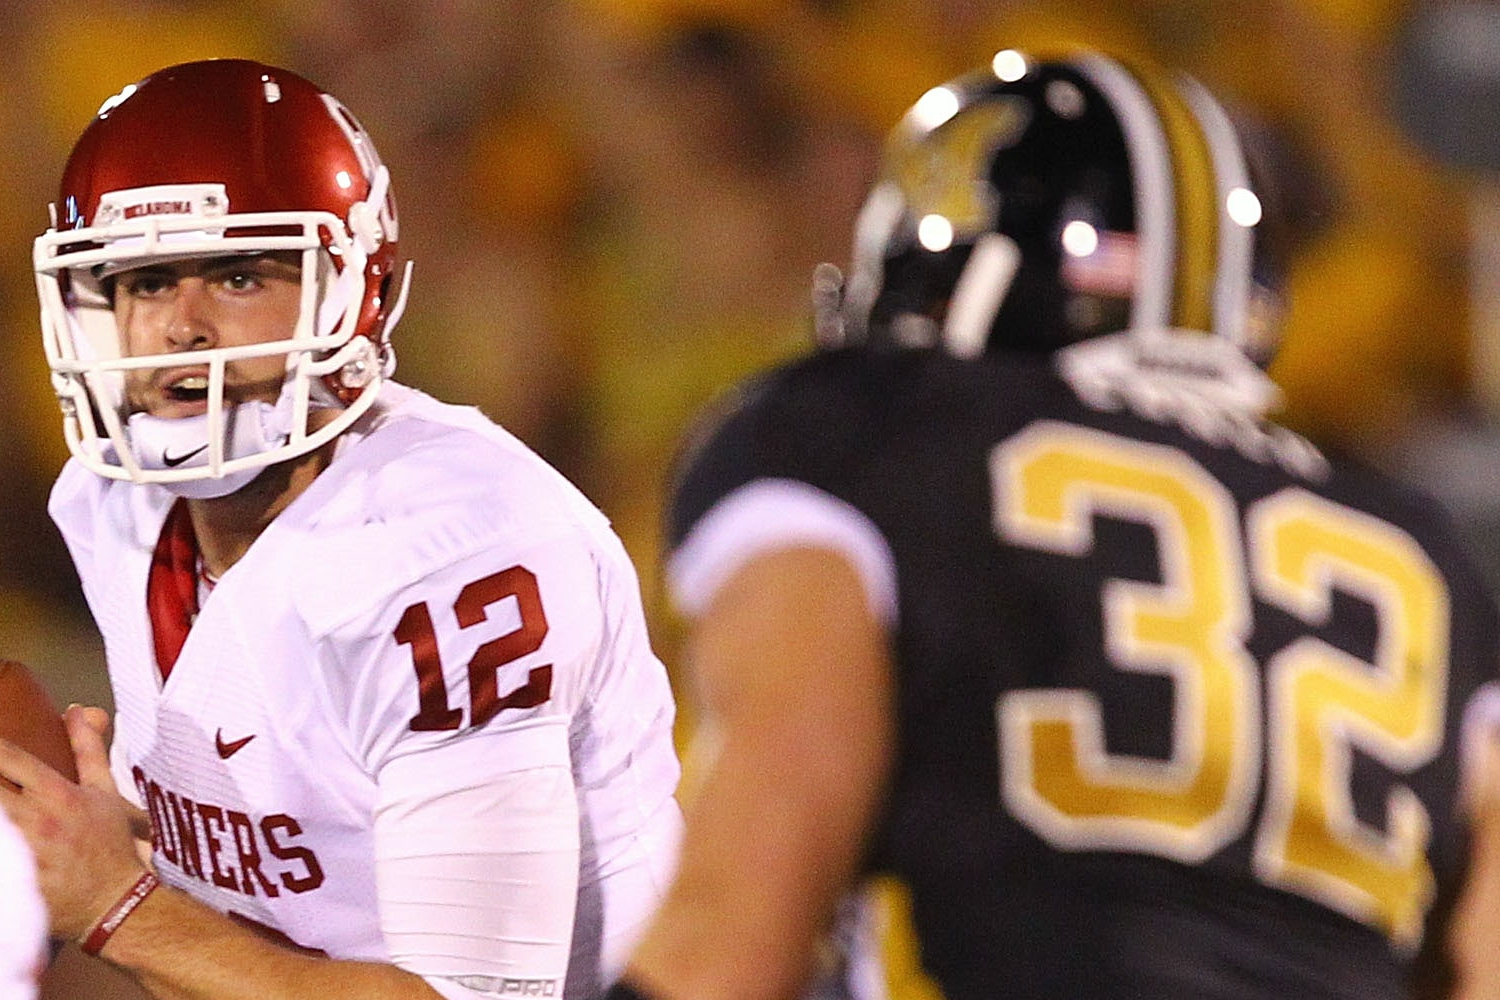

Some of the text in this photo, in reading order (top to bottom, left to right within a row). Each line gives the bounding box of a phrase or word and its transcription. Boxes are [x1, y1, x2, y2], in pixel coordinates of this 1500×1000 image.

[394, 565, 554, 732] 12
[988, 418, 1452, 956] 32
[132, 765, 326, 899] OONERS
